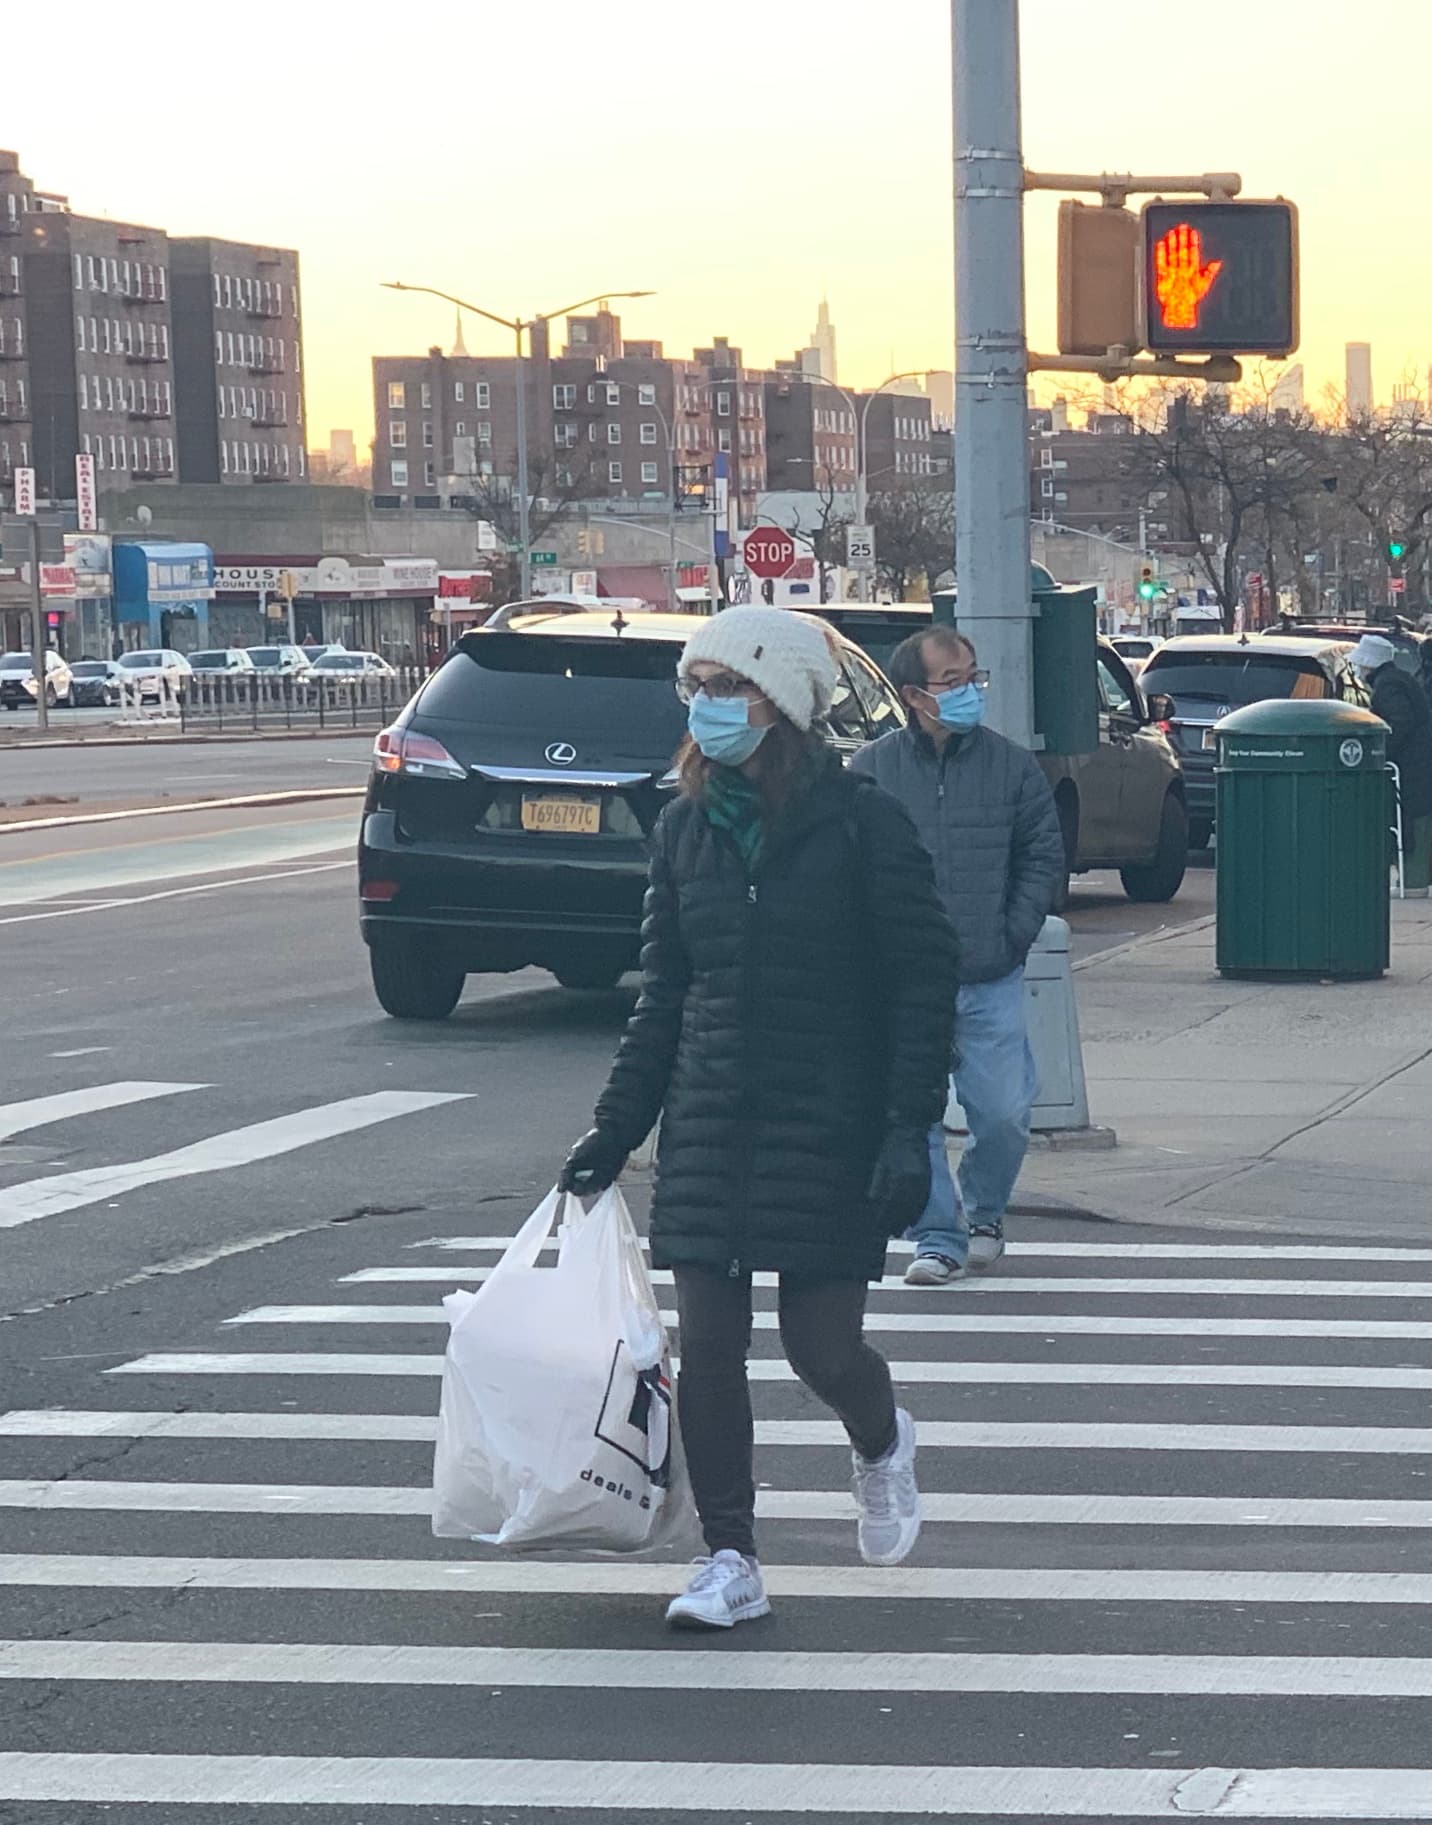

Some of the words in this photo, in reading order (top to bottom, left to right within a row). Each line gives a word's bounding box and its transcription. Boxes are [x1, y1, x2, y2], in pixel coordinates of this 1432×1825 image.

[746, 542, 793, 562] STOP
[850, 543, 871, 557] 25
[254, 581, 276, 589] STO
[529, 803, 593, 825] T696797C
[580, 1468, 633, 1502] deals
